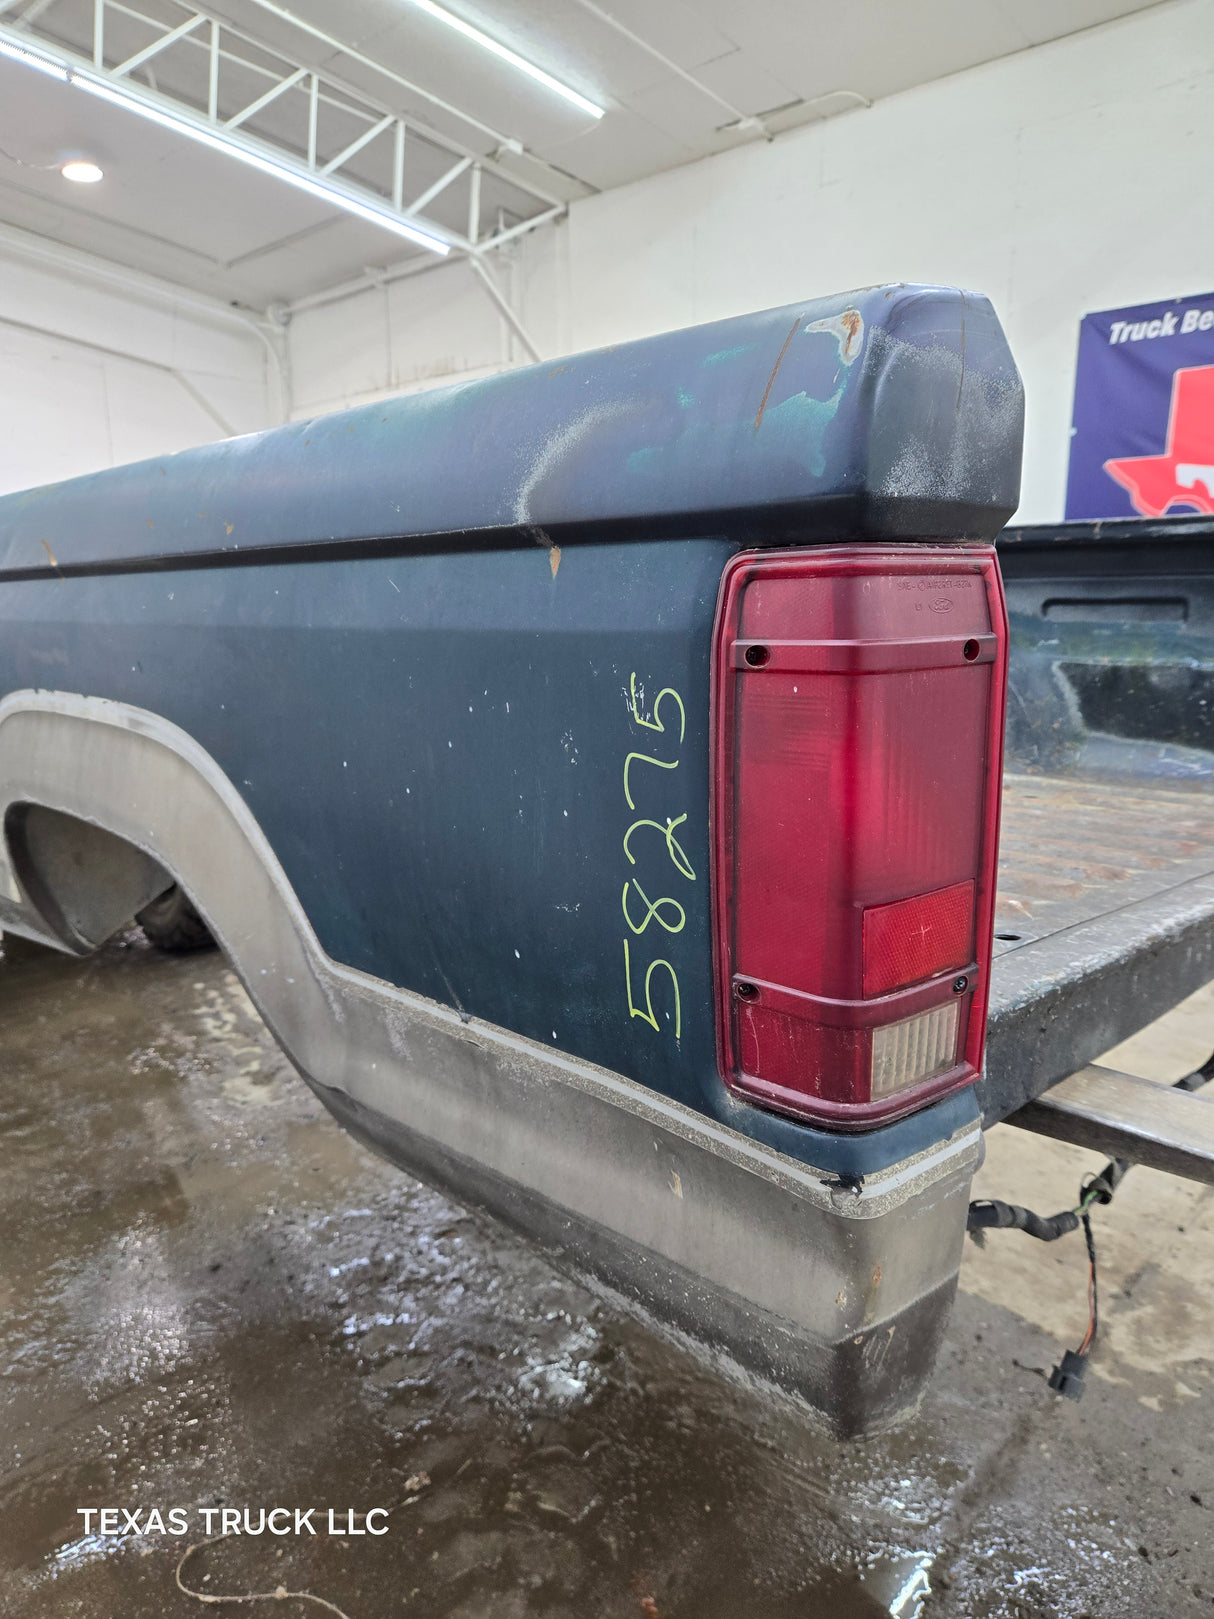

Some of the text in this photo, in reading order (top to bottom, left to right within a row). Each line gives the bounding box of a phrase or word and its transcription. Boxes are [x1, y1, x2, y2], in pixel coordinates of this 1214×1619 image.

[1109, 309, 1214, 345] Truck Be
[622, 672, 696, 1038] 58275
